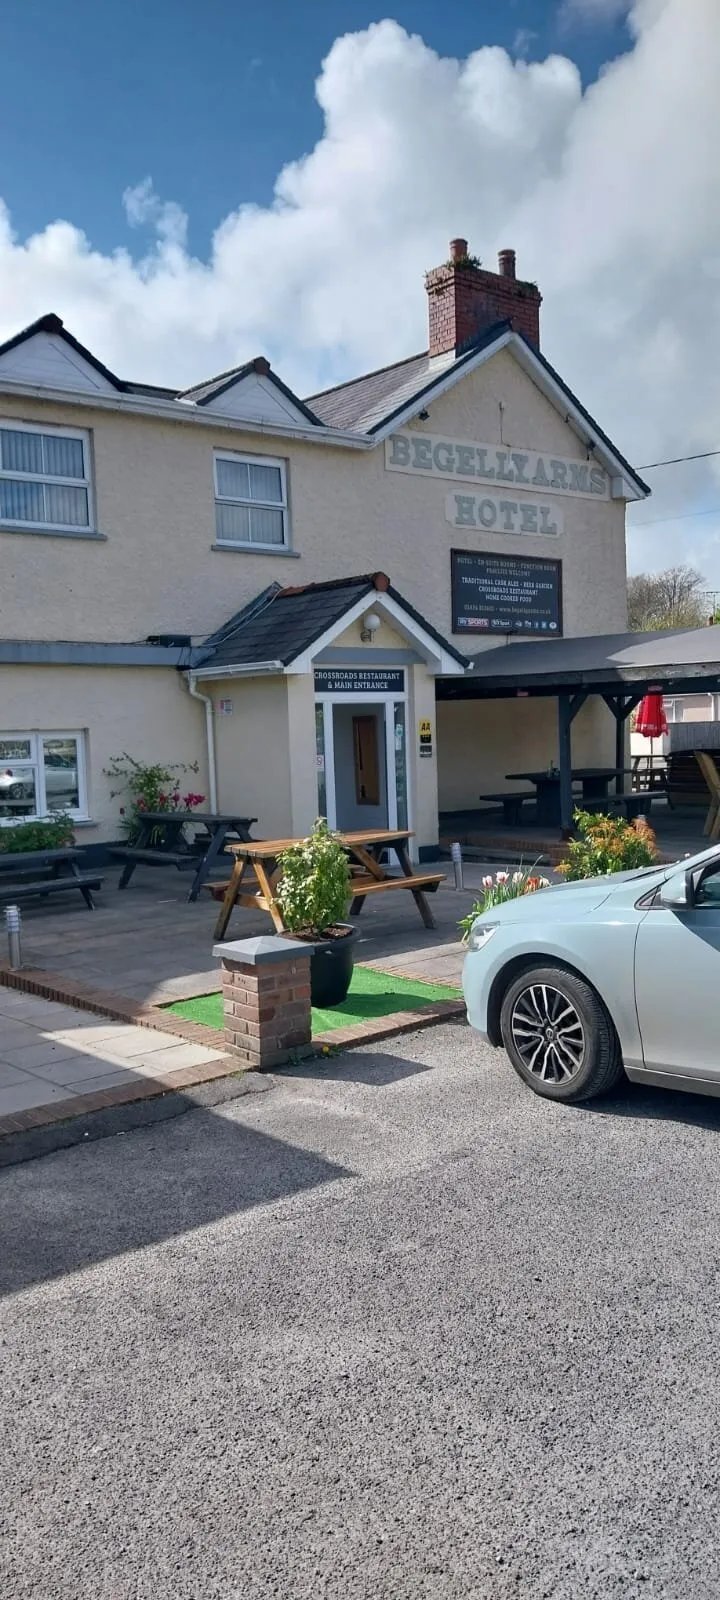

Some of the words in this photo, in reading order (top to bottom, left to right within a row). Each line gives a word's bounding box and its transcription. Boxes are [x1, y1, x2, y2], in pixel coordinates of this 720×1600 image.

[389, 434, 529, 484] BEGELLY
[532, 457, 607, 495] ARMS
[454, 495, 557, 535] HOTEL
[462, 577, 493, 585] TRADITIONAL
[479, 586, 509, 594] CROSSROADS
[510, 587, 538, 596] RESTAURANT
[500, 594, 518, 602] COOKED
[468, 618, 488, 626] SPORTS
[314, 671, 357, 680] CROSSROADS
[359, 672, 400, 680] RESTAURANT
[327, 681, 332, 689] &
[334, 681, 352, 689] MAIN
[353, 681, 388, 689] ENTRANCE
